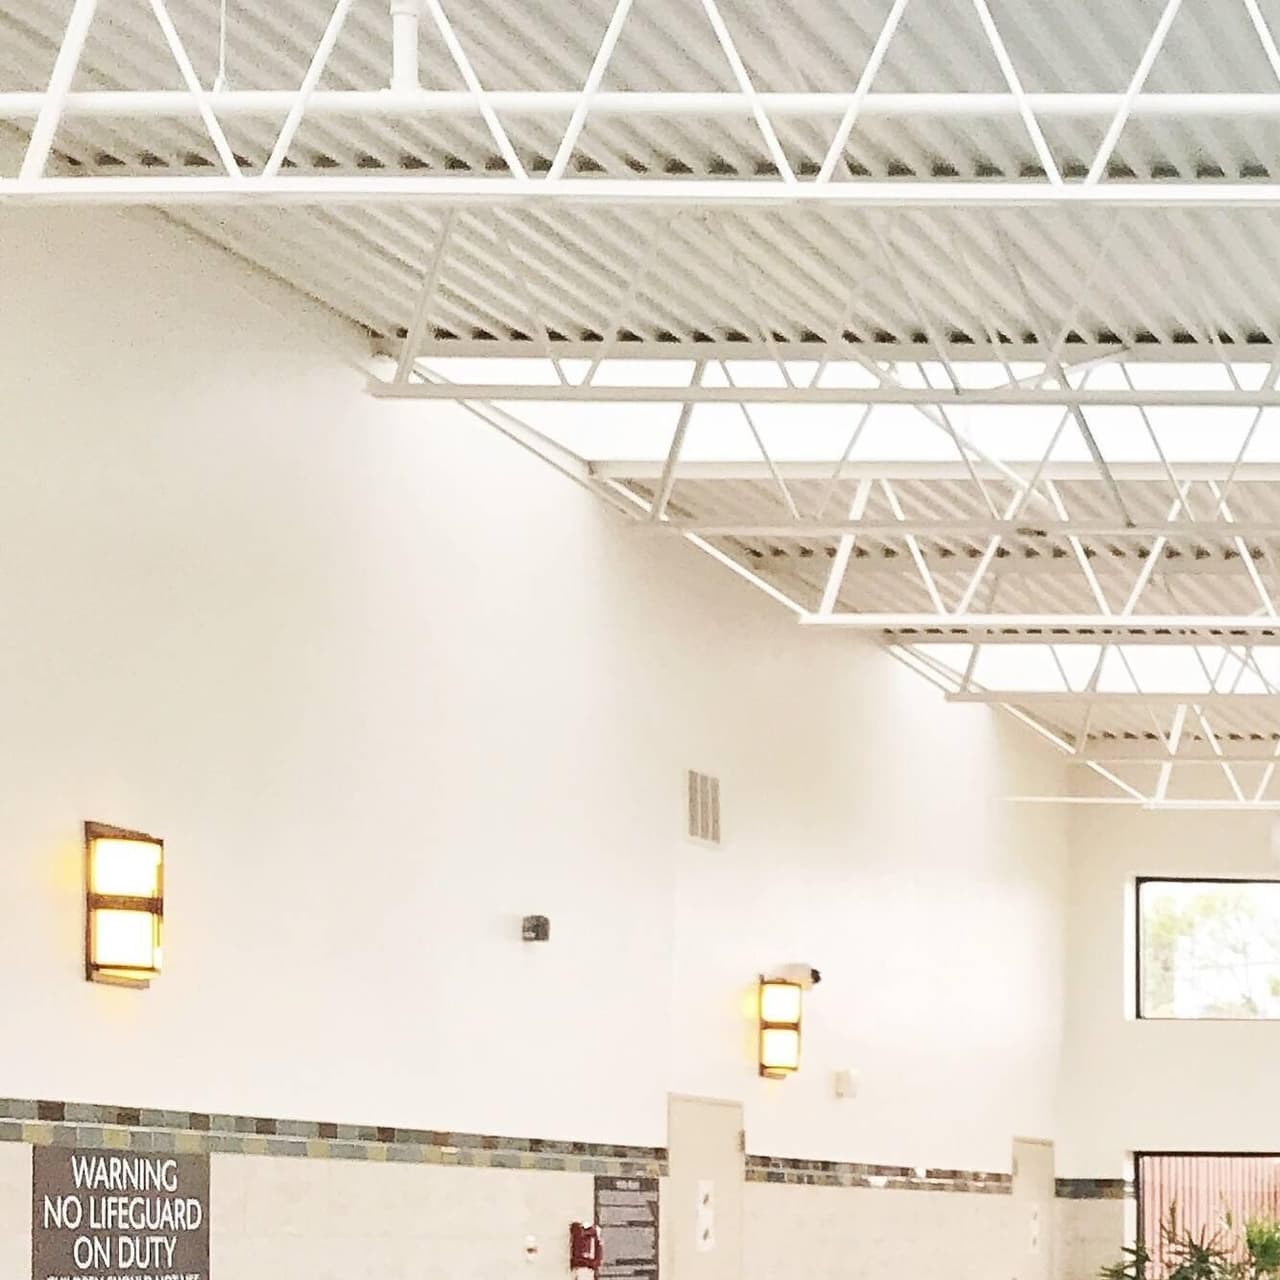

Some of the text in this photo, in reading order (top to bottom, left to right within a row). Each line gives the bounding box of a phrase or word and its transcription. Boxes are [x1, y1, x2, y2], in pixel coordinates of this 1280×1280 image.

[72, 1156, 178, 1192] WARNING
[44, 1195, 202, 1231] NO LIFEGUARD
[73, 1236, 177, 1269] ON DUTY
